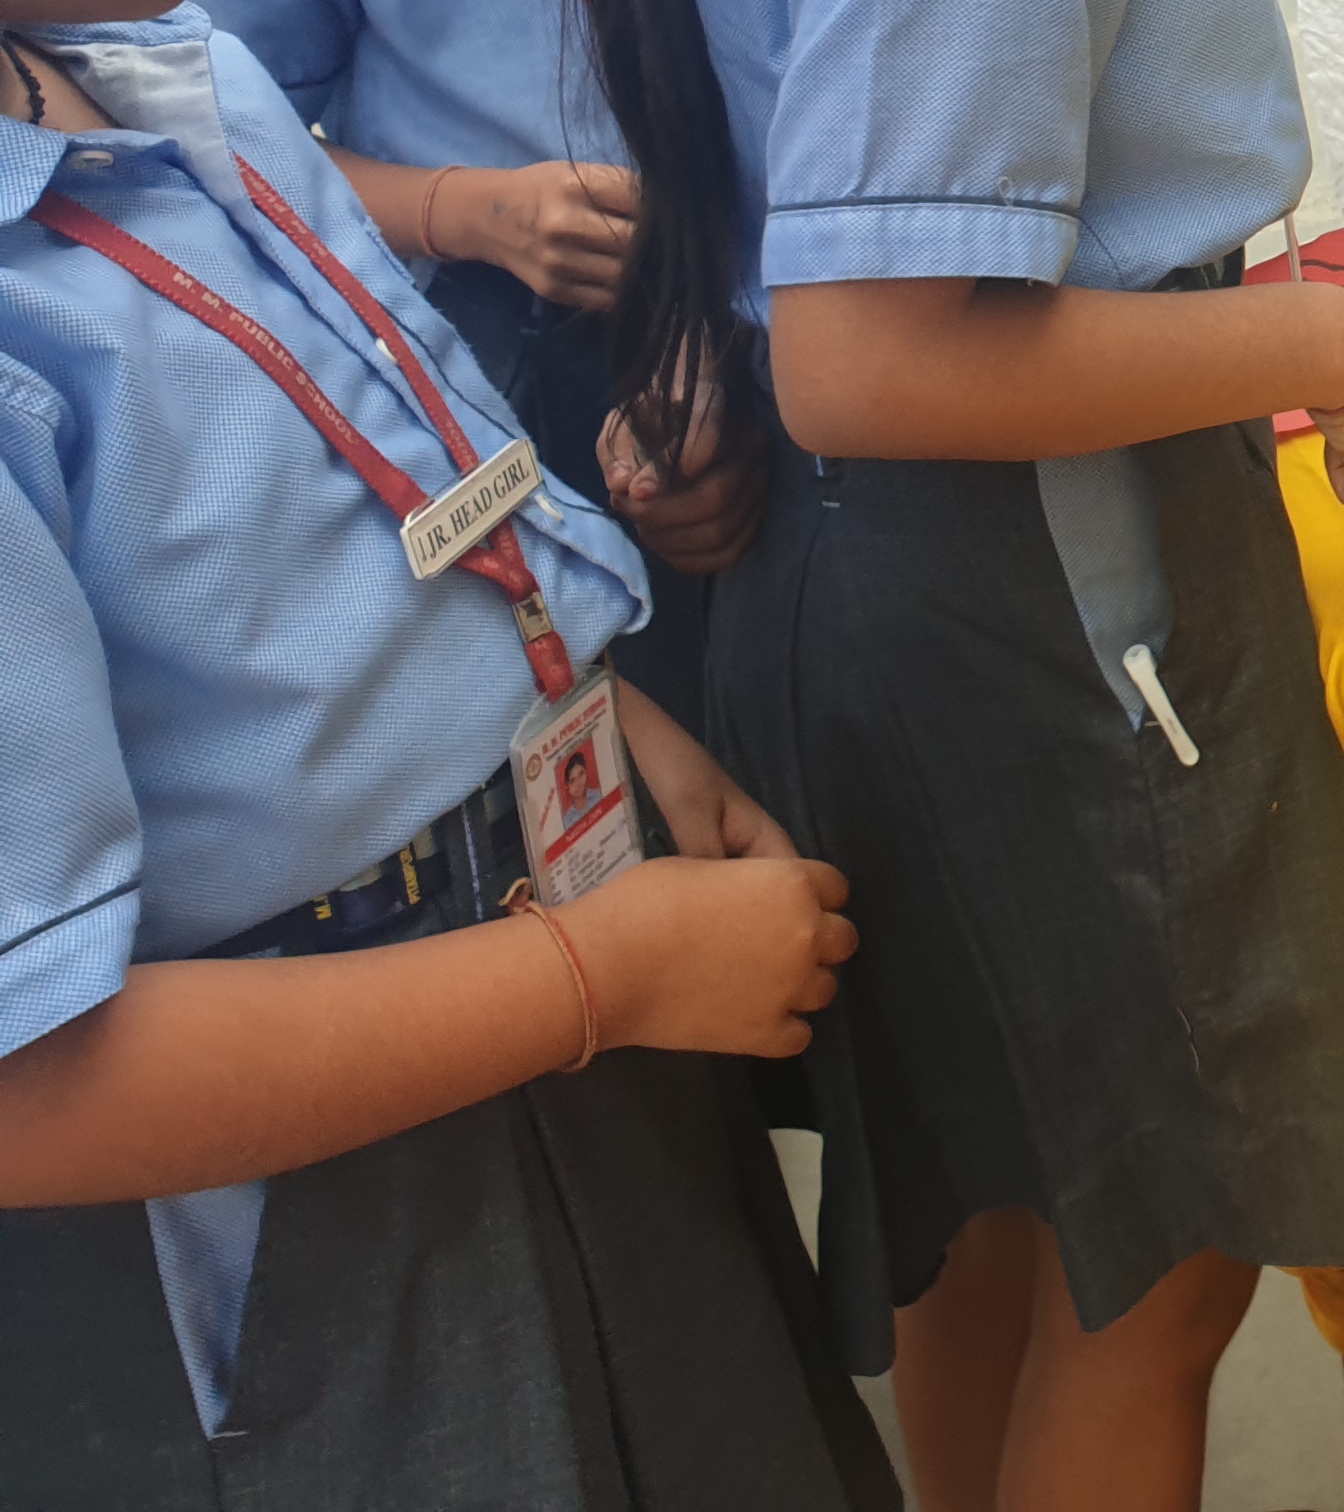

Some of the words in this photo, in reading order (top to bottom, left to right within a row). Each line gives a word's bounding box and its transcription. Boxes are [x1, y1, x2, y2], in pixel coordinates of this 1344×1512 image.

[228, 310, 295, 371] PUBLIC
[449, 486, 493, 537] HEAD
[493, 458, 530, 499] GIRL
